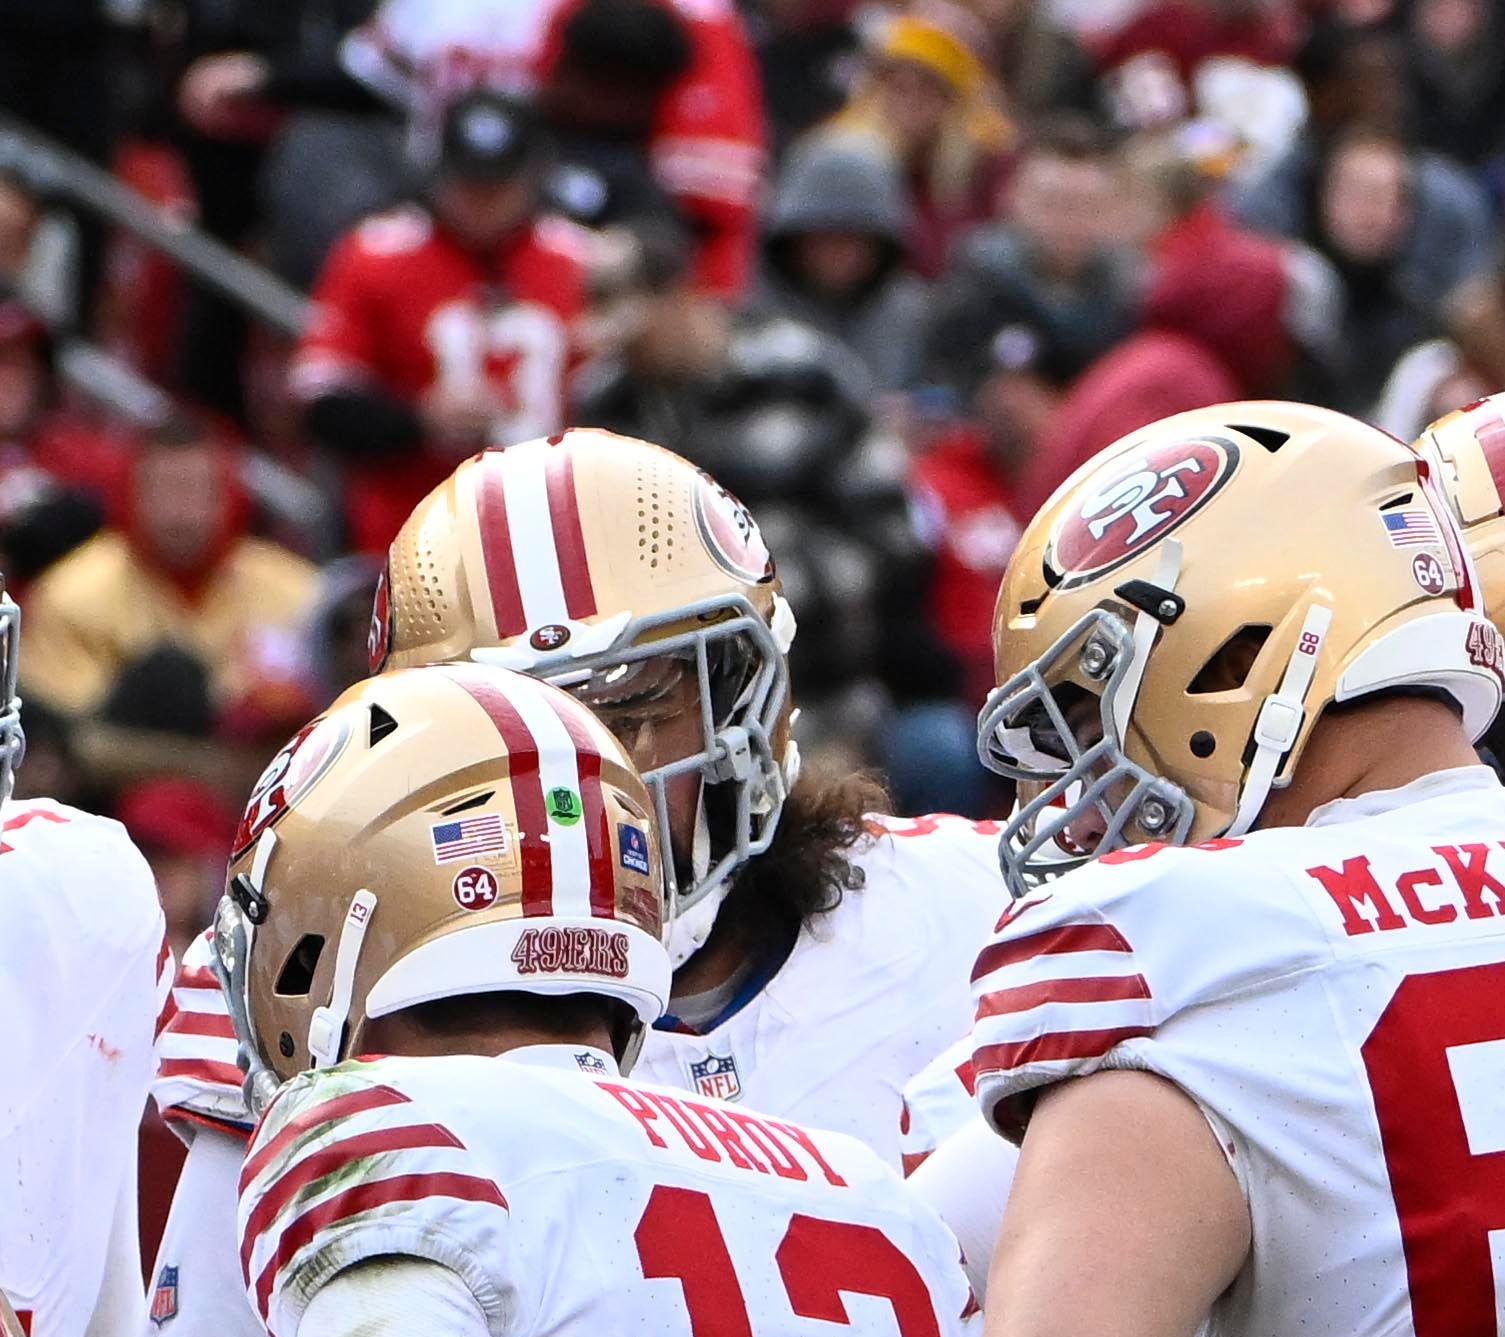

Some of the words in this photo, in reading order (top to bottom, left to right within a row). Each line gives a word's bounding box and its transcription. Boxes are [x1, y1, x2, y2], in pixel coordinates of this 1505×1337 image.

[1414, 559, 1443, 587] 64
[457, 873, 494, 904] 64
[350, 902, 368, 923] 13
[510, 927, 631, 978] 49ERS
[700, 1075, 738, 1098] NFL
[593, 1081, 849, 1188] PURDY
